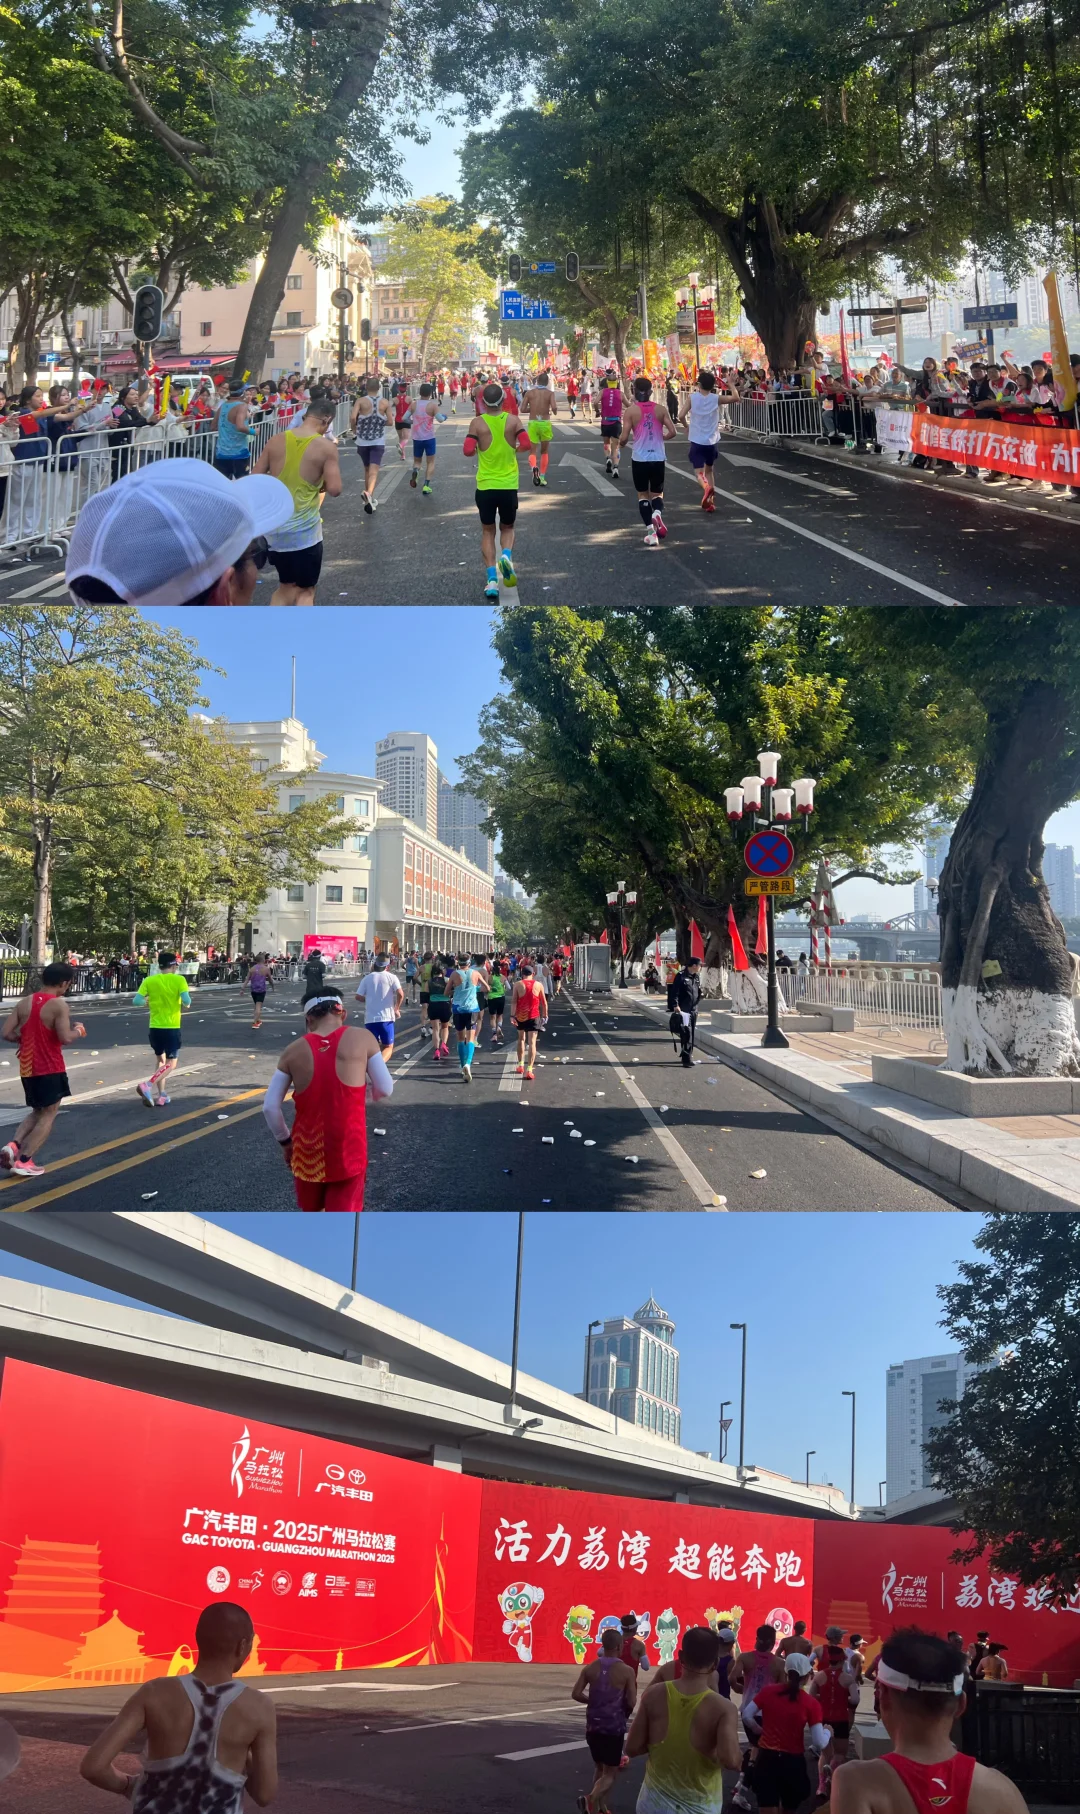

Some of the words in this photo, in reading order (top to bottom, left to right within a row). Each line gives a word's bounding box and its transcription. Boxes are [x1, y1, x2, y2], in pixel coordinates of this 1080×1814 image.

[749, 881, 791, 892] 严管路段
[252, 1447, 285, 1466] 广州
[244, 1461, 284, 1479] 马拉松
[245, 1475, 283, 1487] GUANGZHOU
[248, 1482, 283, 1494] Marathon
[315, 1482, 374, 1502] 广汽丰田
[182, 1533, 209, 1545] GAC
[210, 1536, 255, 1550] TOYOTA
[262, 1541, 326, 1557] GUANGZHOU
[326, 1548, 376, 1562] MARATHON
[376, 1553, 395, 1564] 2025
[494, 1517, 651, 1574] 活力荔湾
[668, 1537, 805, 1589] 超能奔跑
[899, 1575, 928, 1587] 广州
[298, 1589, 318, 1597] AIMS
[892, 1587, 928, 1597] 马拉松
